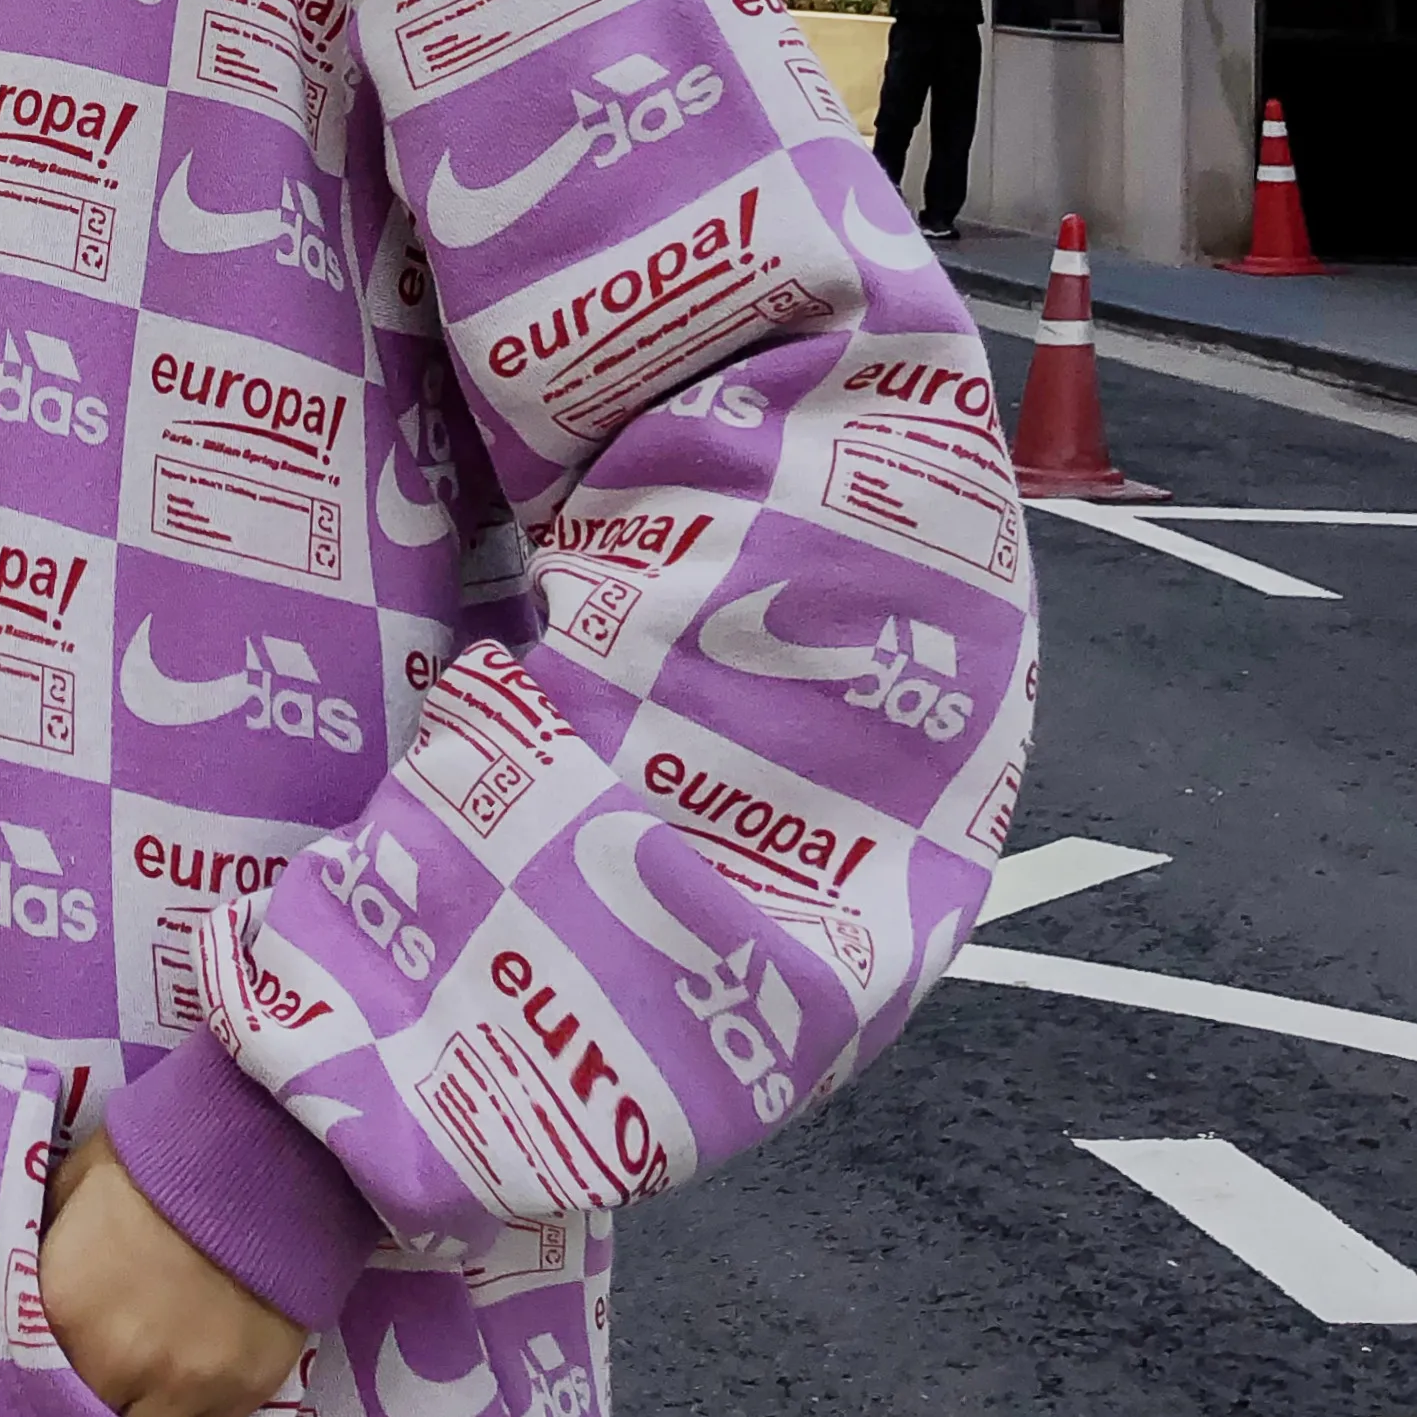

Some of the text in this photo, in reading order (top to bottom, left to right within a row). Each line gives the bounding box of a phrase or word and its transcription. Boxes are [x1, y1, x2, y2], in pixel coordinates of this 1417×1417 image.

[9, 155, 48, 173] Spring
[588, 64, 724, 169] das
[275, 210, 344, 291] das
[488, 187, 759, 378] europa!
[151, 352, 347, 466] europa!
[245, 685, 364, 754] das
[644, 752, 877, 898] europa!
